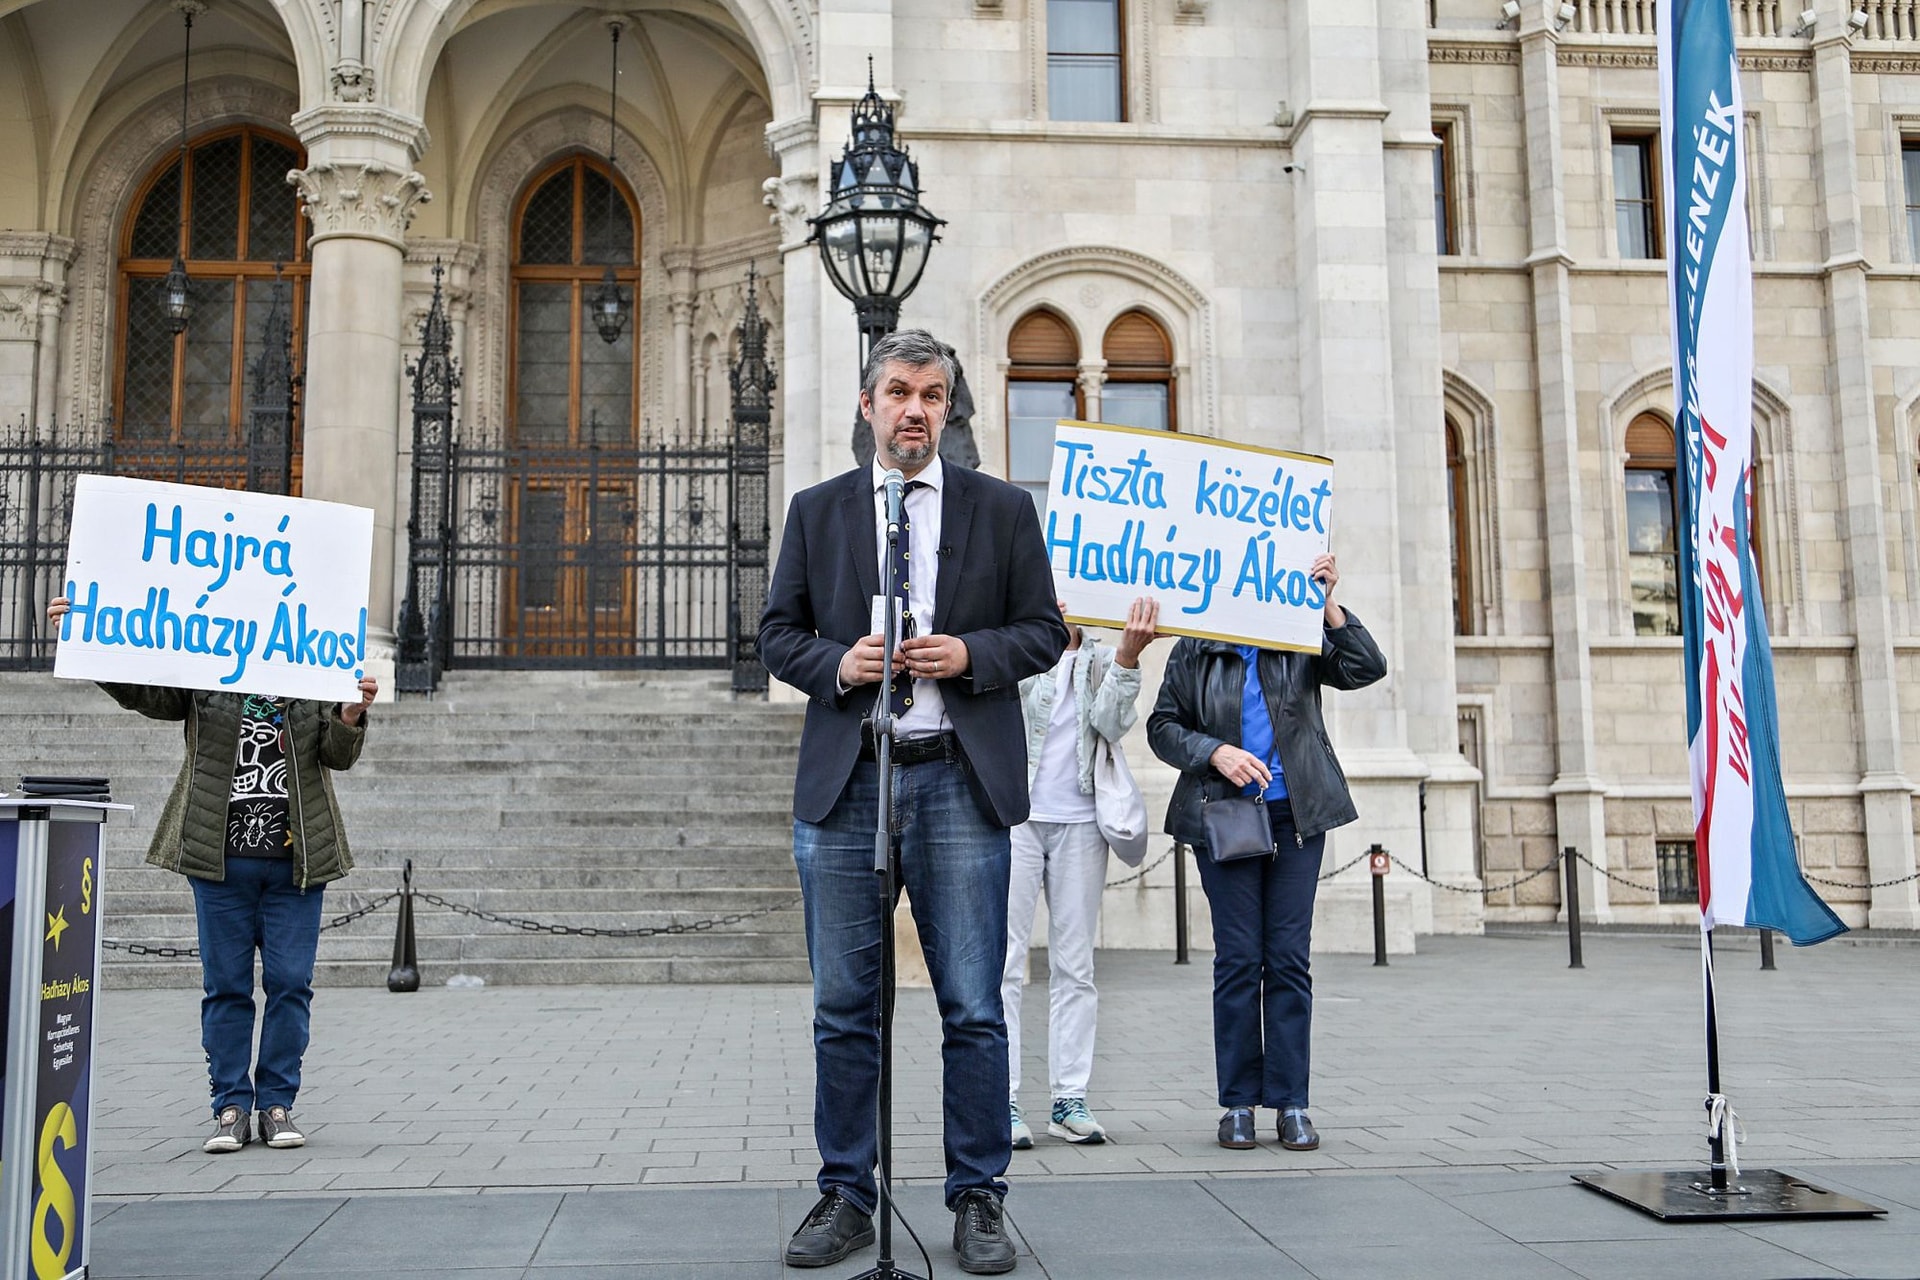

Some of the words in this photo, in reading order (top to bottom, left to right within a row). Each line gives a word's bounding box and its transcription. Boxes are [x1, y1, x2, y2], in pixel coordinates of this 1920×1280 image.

[1055, 440, 1168, 510] Tiszta
[1195, 459, 1332, 535] közélet
[142, 502, 294, 593] Hajrá
[1046, 510, 1222, 615] Hadházy
[1232, 530, 1326, 611] Ákos
[61, 580, 258, 686] Hadházy
[262, 581, 368, 681] Ákos!
[41, 979, 72, 1001] Hadházy
[72, 973, 89, 995] Ákos
